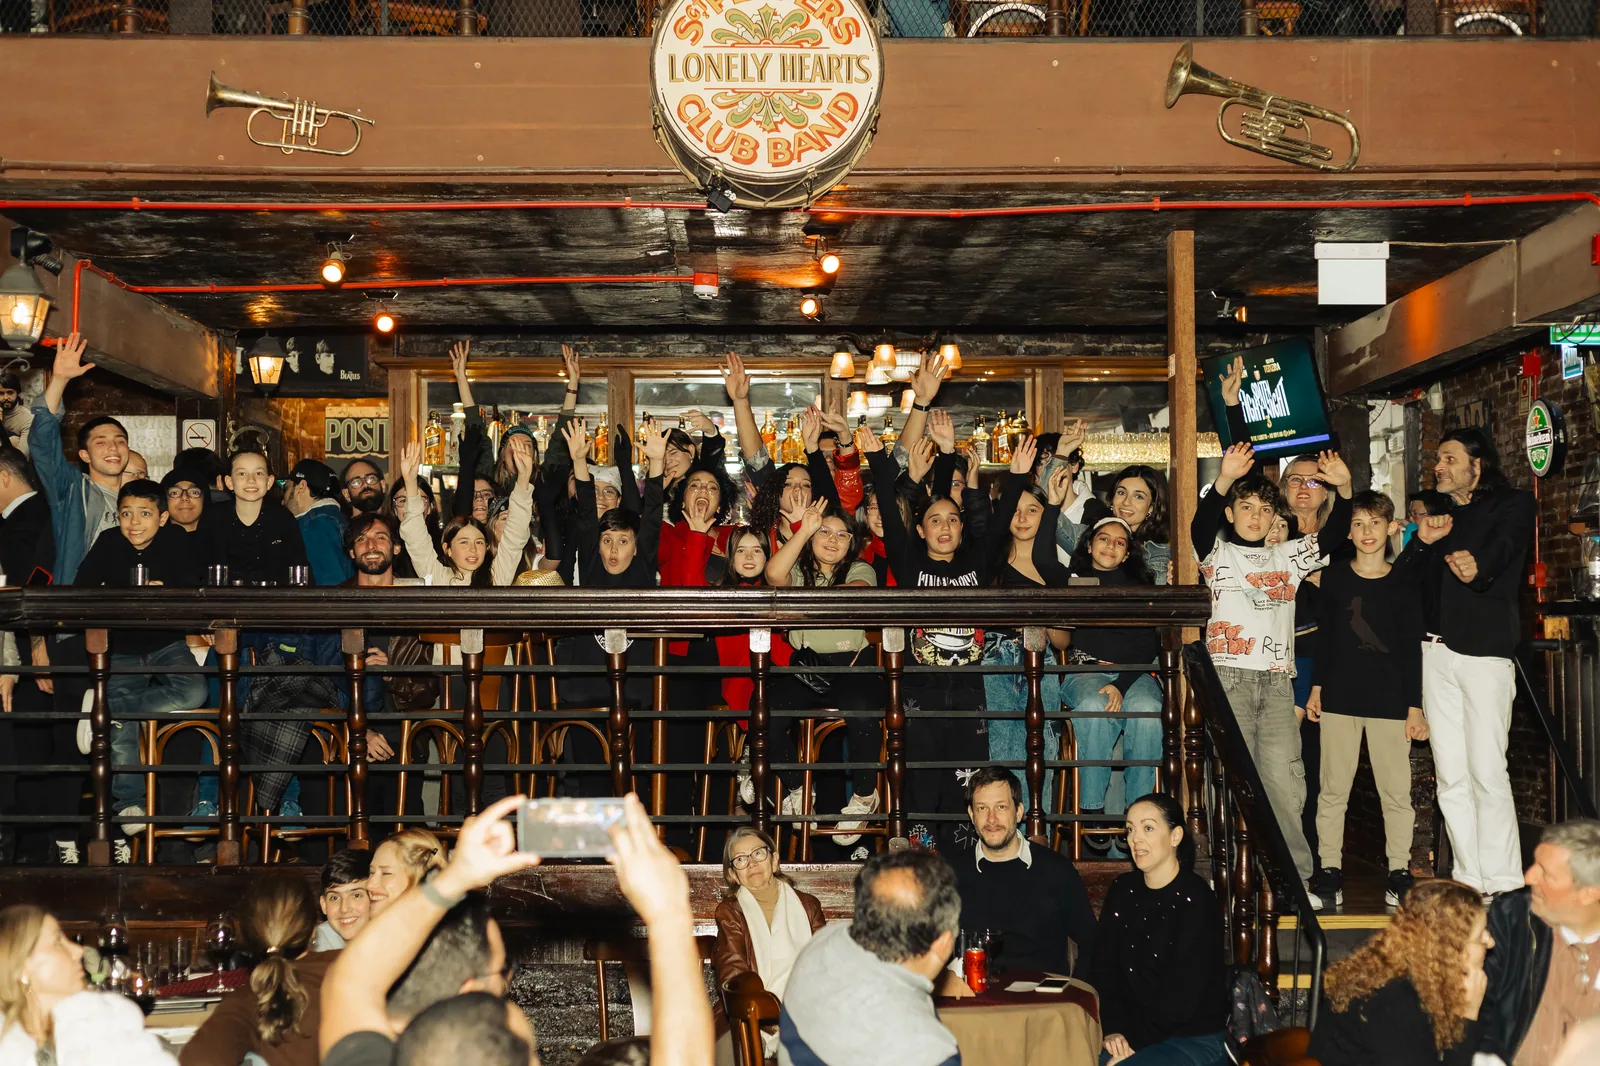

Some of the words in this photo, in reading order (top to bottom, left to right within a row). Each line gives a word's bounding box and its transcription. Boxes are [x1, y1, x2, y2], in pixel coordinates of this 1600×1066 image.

[668, 53, 773, 83] LONELY
[780, 53, 872, 84] HEARTS
[677, 93, 760, 165] CLUB
[767, 92, 859, 167] BAND
